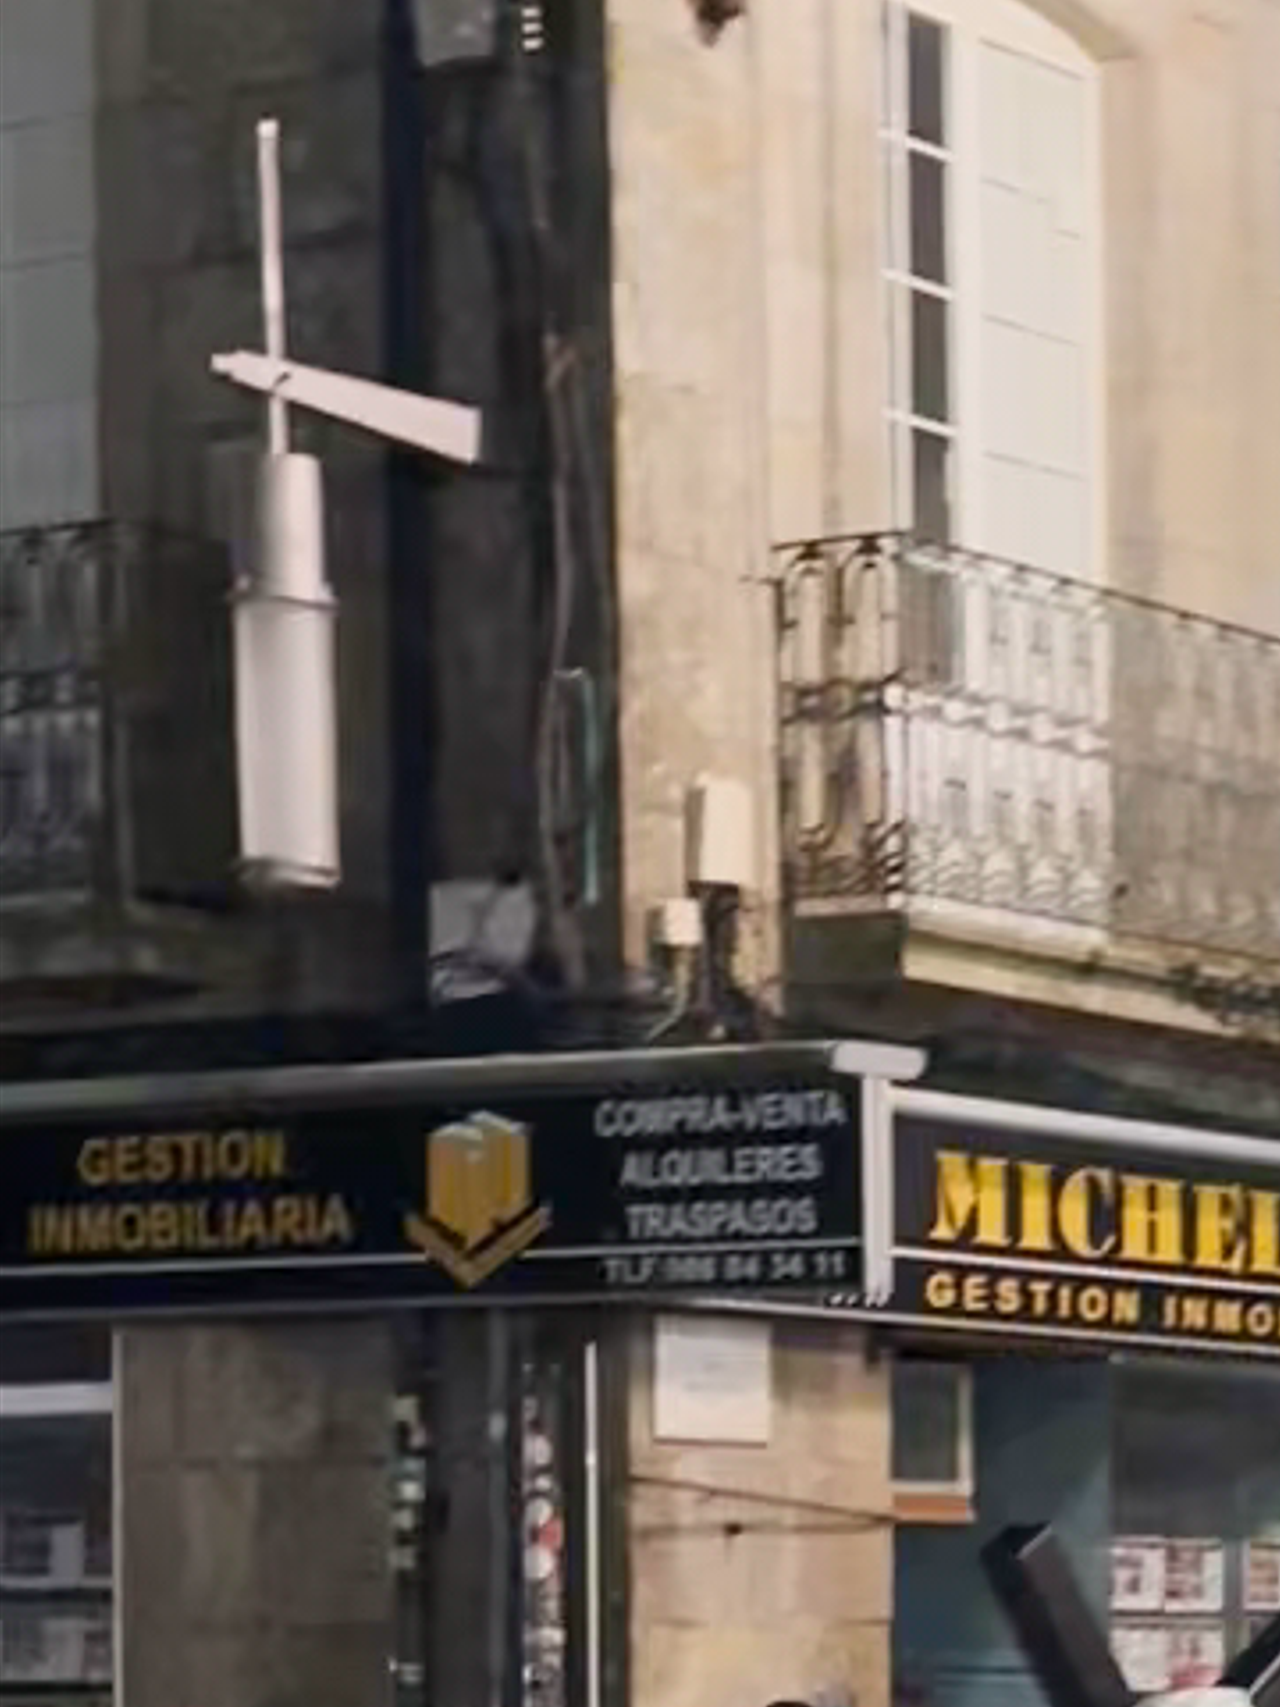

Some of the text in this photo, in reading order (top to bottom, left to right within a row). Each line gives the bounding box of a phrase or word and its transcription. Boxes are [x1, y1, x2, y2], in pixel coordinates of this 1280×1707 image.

[594, 1089, 849, 1137] COMPRA-VENTA
[78, 1131, 287, 1185] GESTION
[619, 1142, 824, 1188] ALQUILERES
[27, 1199, 356, 1258] INMOBILIARIA
[624, 1196, 819, 1239] TRASPASOS
[925, 1268, 1142, 1326] GESTION
